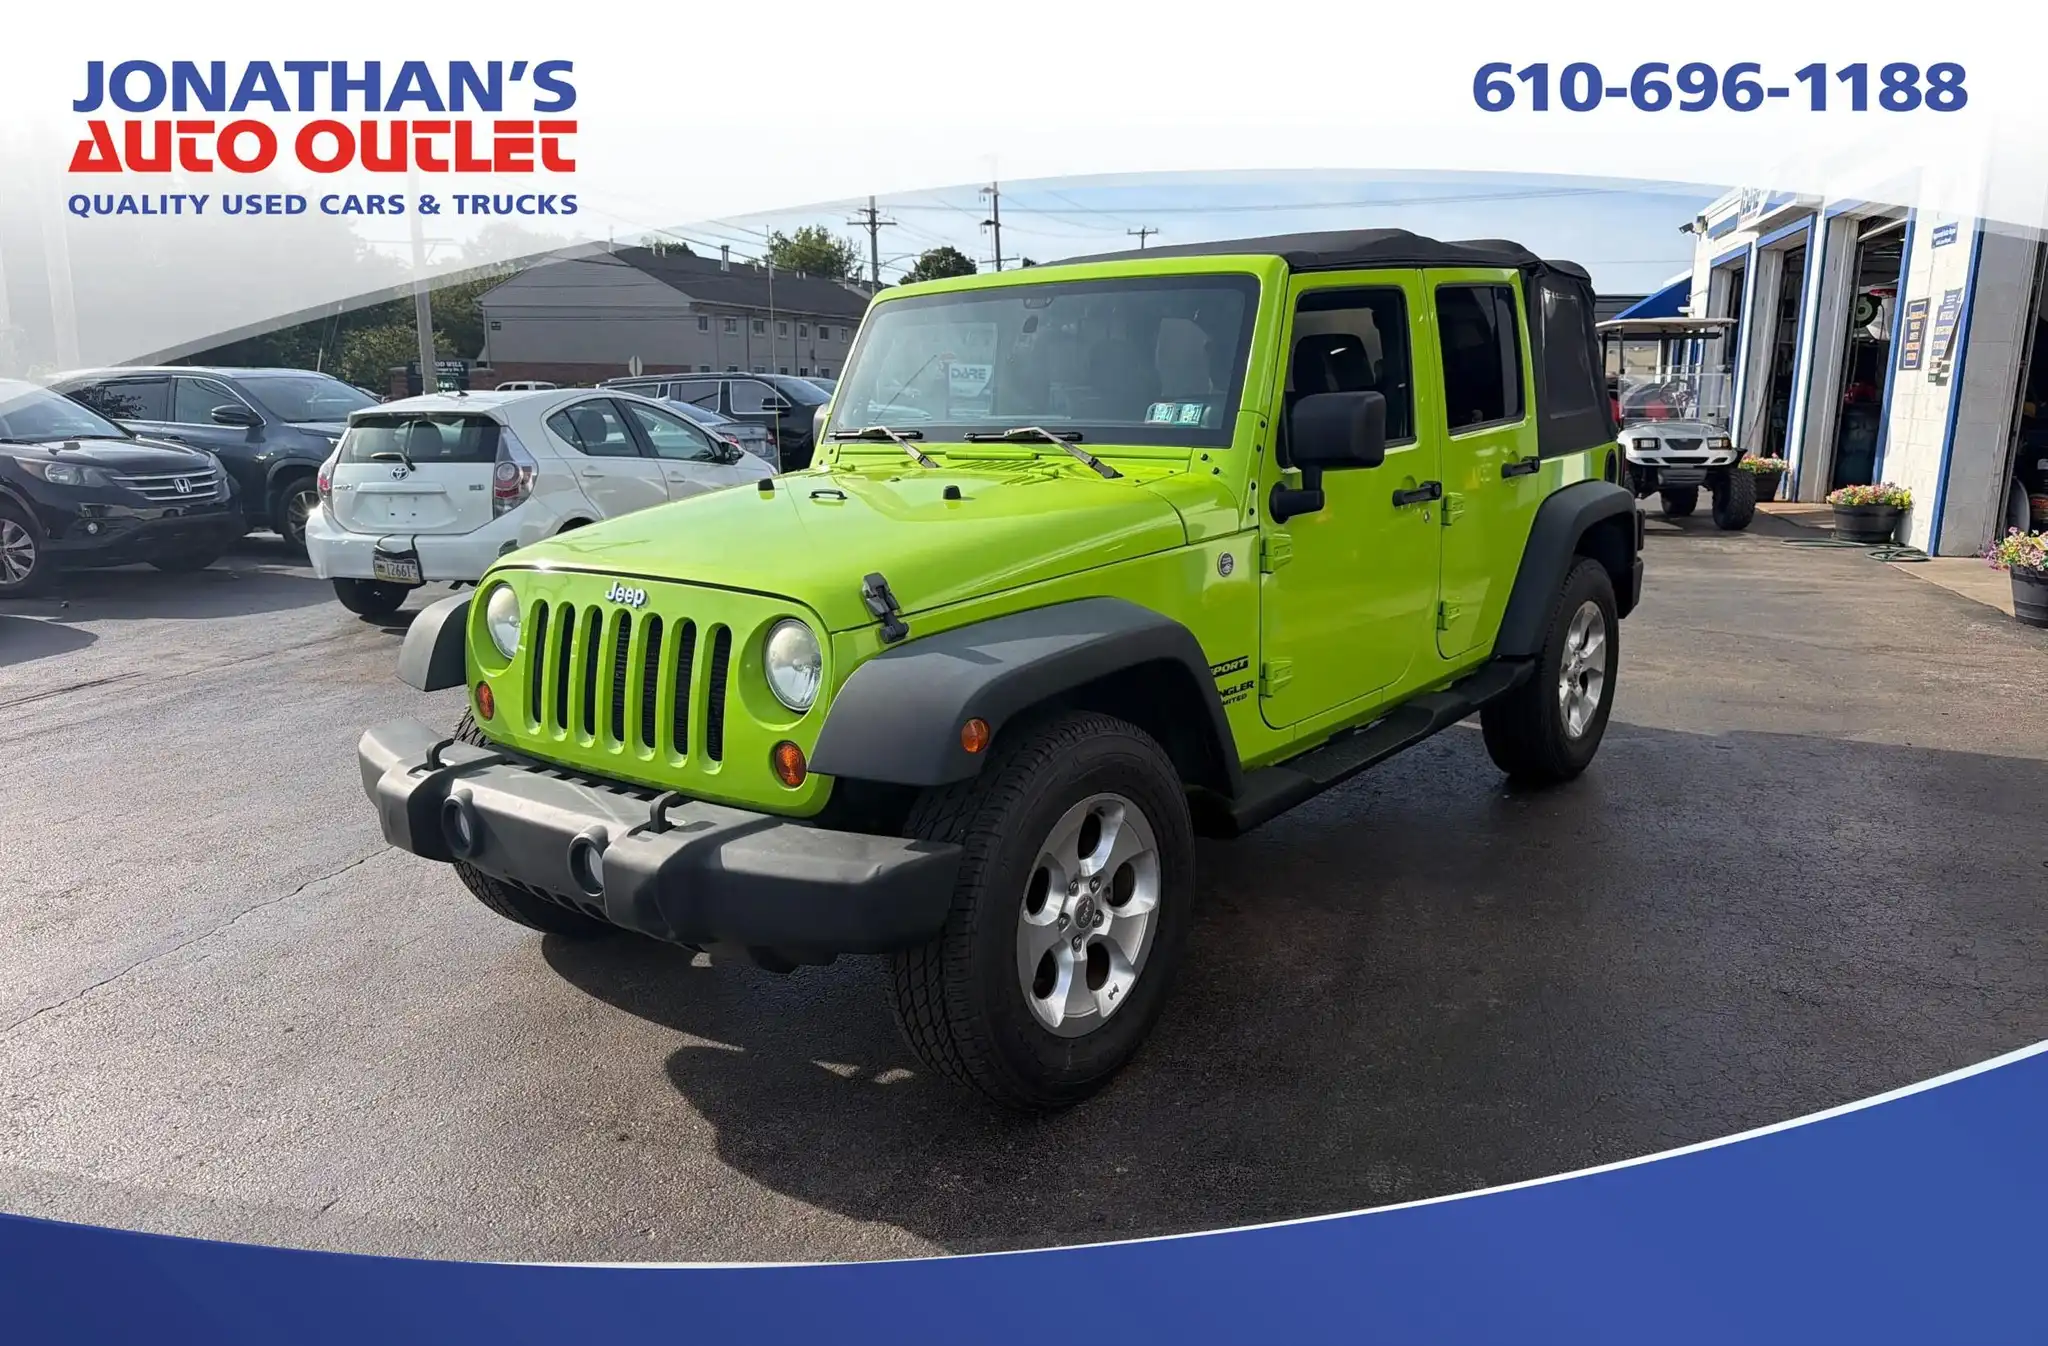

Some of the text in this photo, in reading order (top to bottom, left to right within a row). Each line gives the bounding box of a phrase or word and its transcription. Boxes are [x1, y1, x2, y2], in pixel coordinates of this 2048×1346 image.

[605, 580, 646, 608] Jeep
[1211, 658, 1248, 676] PORT
[1220, 680, 1255, 697] NGLER
[1222, 693, 1248, 705] MITED
